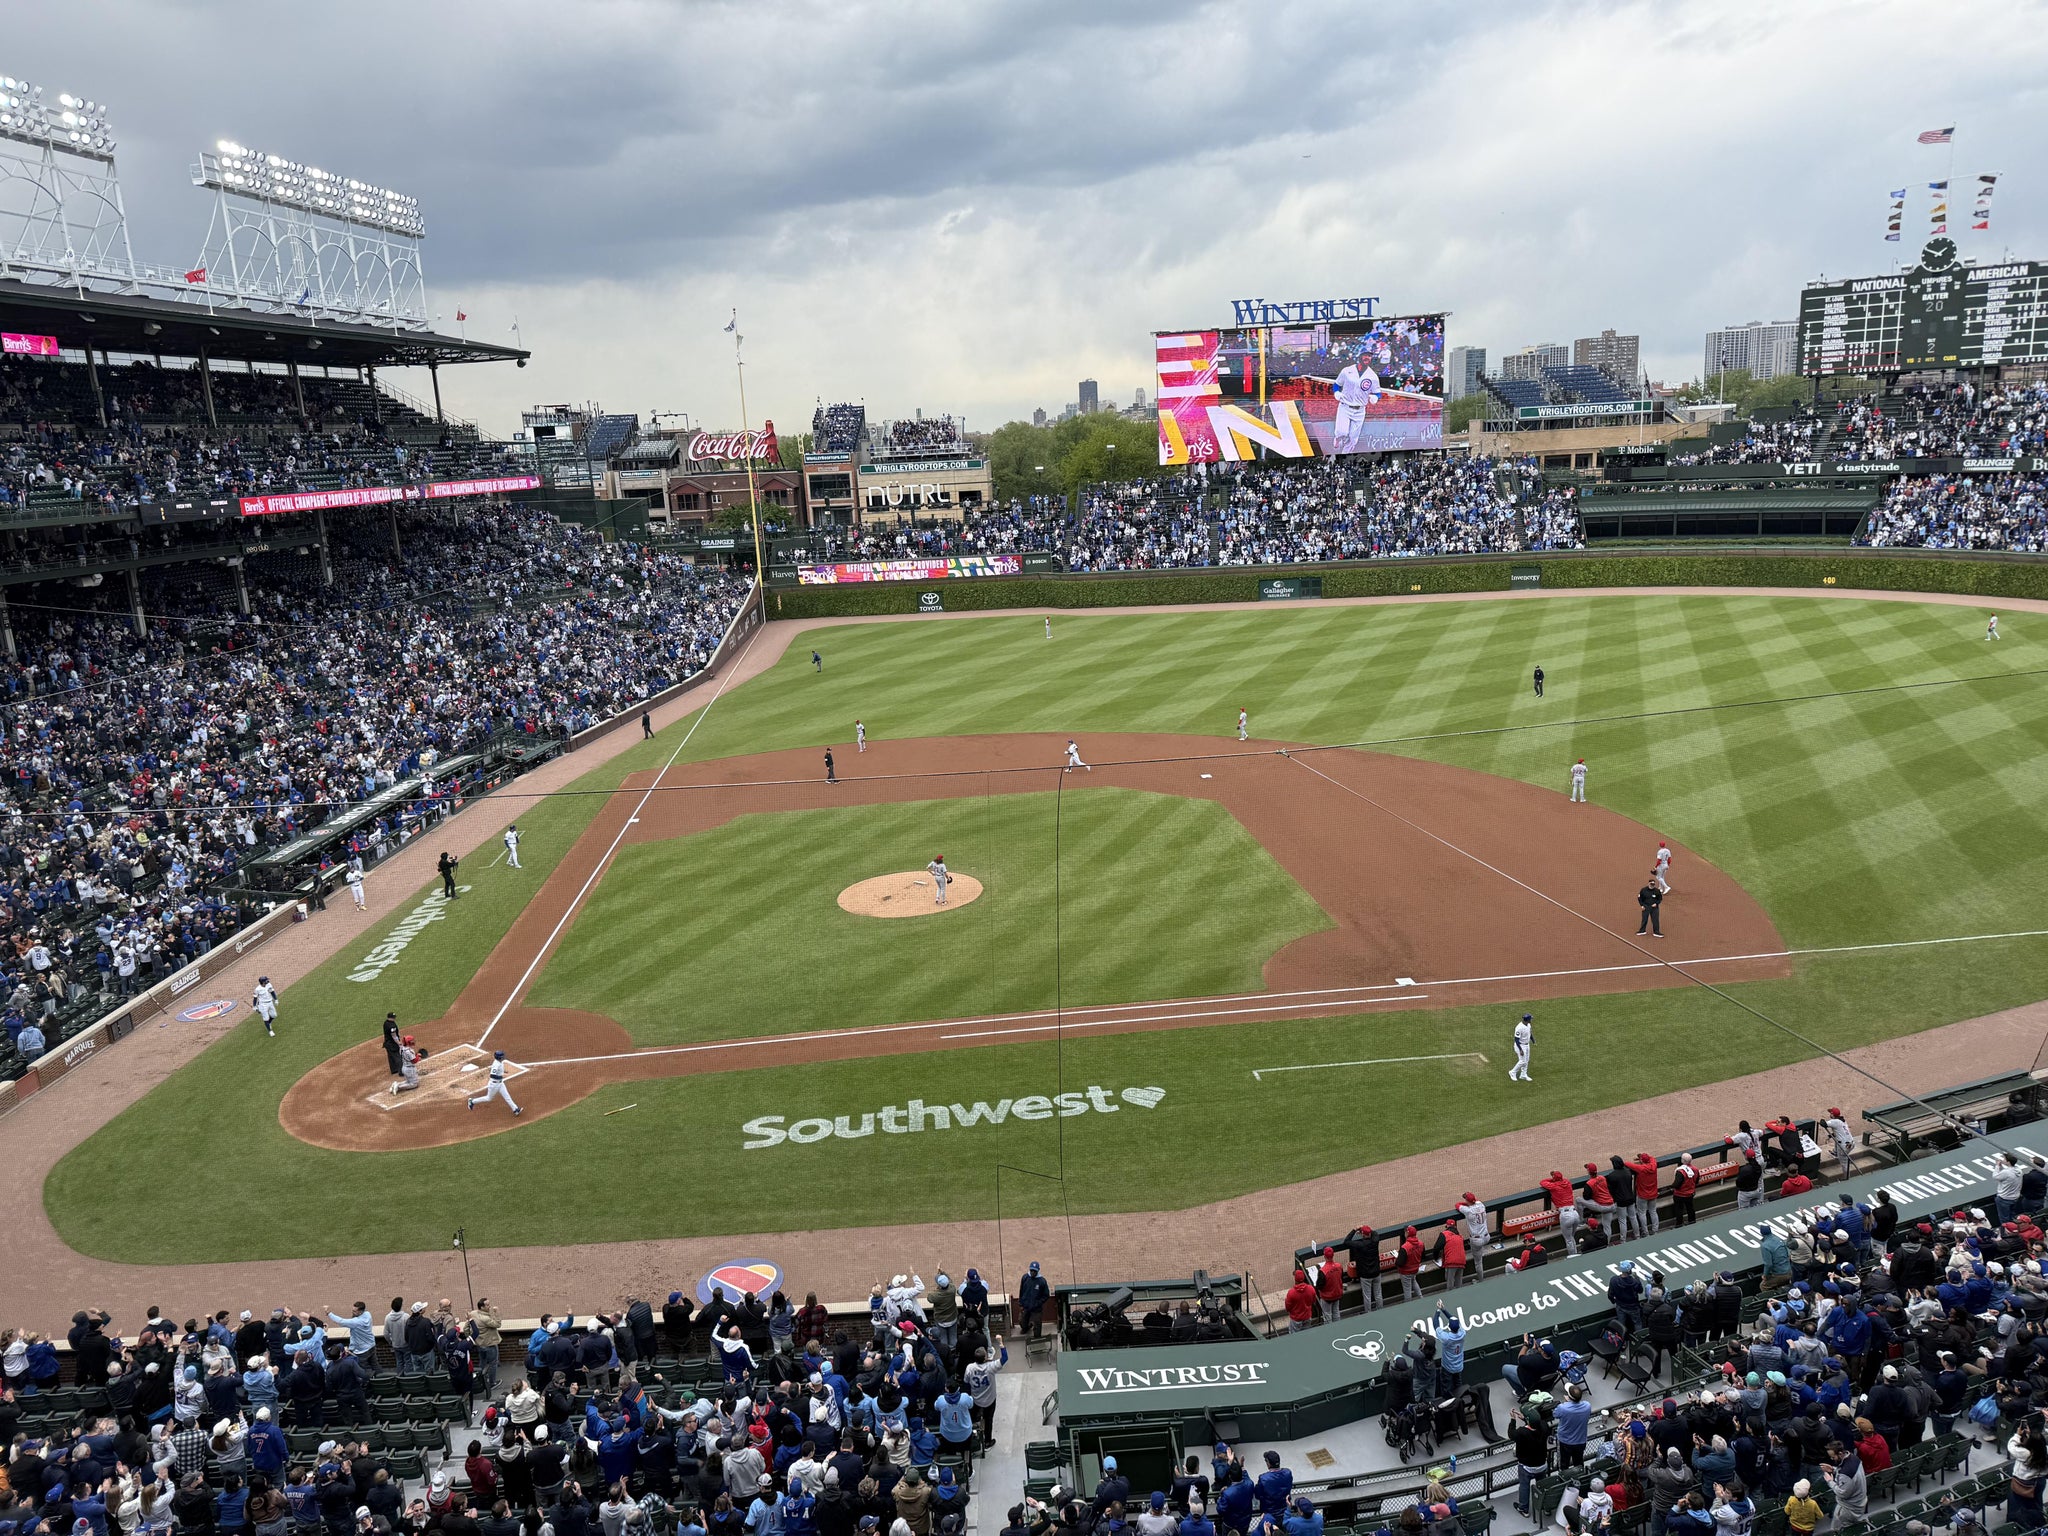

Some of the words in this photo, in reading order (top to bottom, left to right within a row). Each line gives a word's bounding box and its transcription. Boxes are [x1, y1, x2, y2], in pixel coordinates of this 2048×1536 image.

[1966, 265, 2029, 280] AMERICAN
[1852, 277, 1907, 292] NATIONAL
[1921, 276, 1953, 284] UMPIRES
[1922, 292, 1949, 301] BATTER
[1231, 297, 1379, 326] WINTRUST
[1925, 300, 1944, 312] 20
[4, 338, 32, 351] Binny's
[1927, 343, 1936, 354] 2
[1538, 404, 1634, 417] WRIGLEYROOFTOPS.COM
[688, 430, 772, 461] Coca-Cola
[1165, 438, 1214, 458] Bny's
[1627, 445, 1654, 454] Mobile
[874, 461, 968, 472] WRIGLEYROOFTOPS.COM
[1783, 462, 1822, 475] YETI
[1844, 463, 1900, 473] tastytrade
[1963, 458, 2016, 467] GRAINGER
[244, 499, 265, 513] Binny's
[268, 497, 294, 512] OFFICIAL
[295, 494, 328, 509] CHAMPAGNE
[328, 492, 352, 506] PROVIDER
[352, 492, 360, 504] OF
[360, 491, 370, 503] THE
[370, 490, 390, 502] CHICAGO
[391, 488, 403, 500] CUBS
[846, 562, 873, 573] OFFICIAL
[917, 560, 944, 570] PROVIDER
[772, 571, 796, 579] Harvey
[171, 968, 199, 992] GRAINGER
[64, 1040, 96, 1066] MARQUEE
[742, 1086, 1120, 1150] Southwest
[1972, 1146, 2048, 1181] FID
[1700, 1170, 1728, 1182] ATORADE
[1521, 1218, 1556, 1230] GATORADE
[1412, 1306, 1531, 1339] Wlcome
[1531, 1292, 1560, 1313] to
[1548, 1270, 1610, 1301] THE
[973, 1376, 989, 1388] 34
[952, 1412, 958, 1423] 4
[255, 1440, 264, 1453] 7
